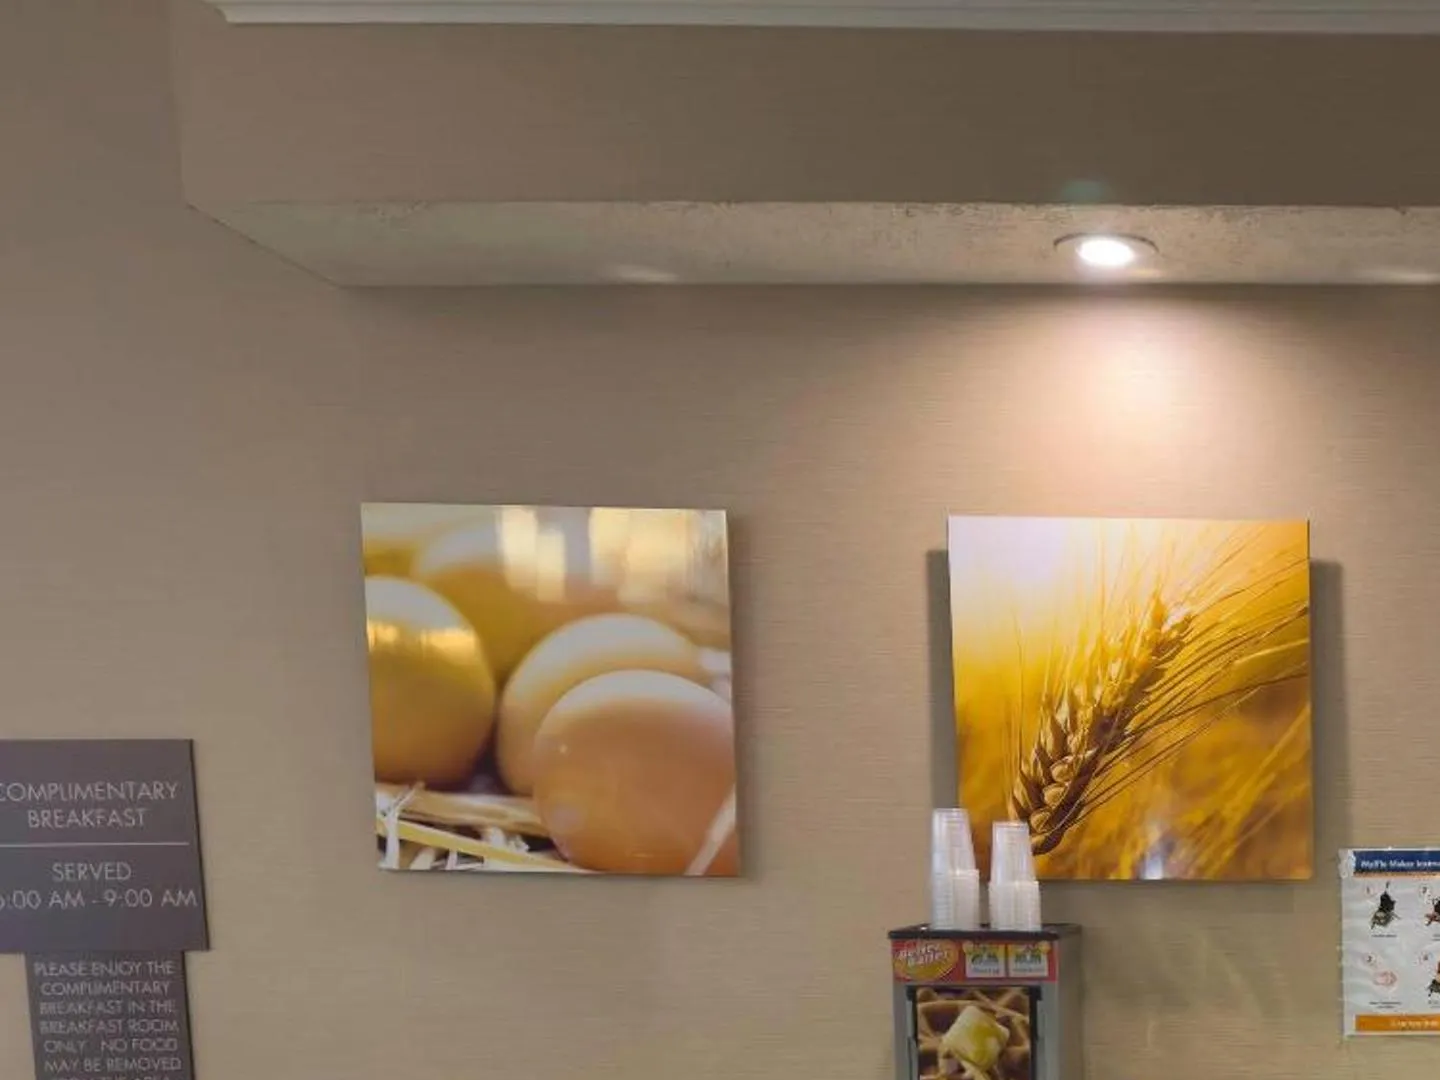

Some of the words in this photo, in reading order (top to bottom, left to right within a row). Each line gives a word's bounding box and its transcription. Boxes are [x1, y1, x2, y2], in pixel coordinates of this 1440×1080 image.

[27, 808, 148, 828] BREAKFAST
[52, 861, 132, 881] SERVED
[49, 890, 86, 909] AM
[104, 888, 152, 908] 9:00
[161, 889, 198, 908] AM
[33, 962, 88, 976] PLEASE
[91, 960, 142, 976] ENJOY
[147, 961, 175, 975] THE
[40, 980, 170, 995] COMPLIMENTARY
[39, 1000, 122, 1015] BREAKFAST
[128, 1000, 146, 1014] IN
[150, 999, 176, 1013] THE
[39, 1019, 123, 1034] BREAKFAST
[128, 1018, 179, 1033] ROOM
[101, 1039, 128, 1052] NO
[132, 1038, 178, 1051] FOOD
[44, 1059, 80, 1073] MAY
[84, 1059, 101, 1072] BE
[106, 1057, 181, 1072] REMOVED
